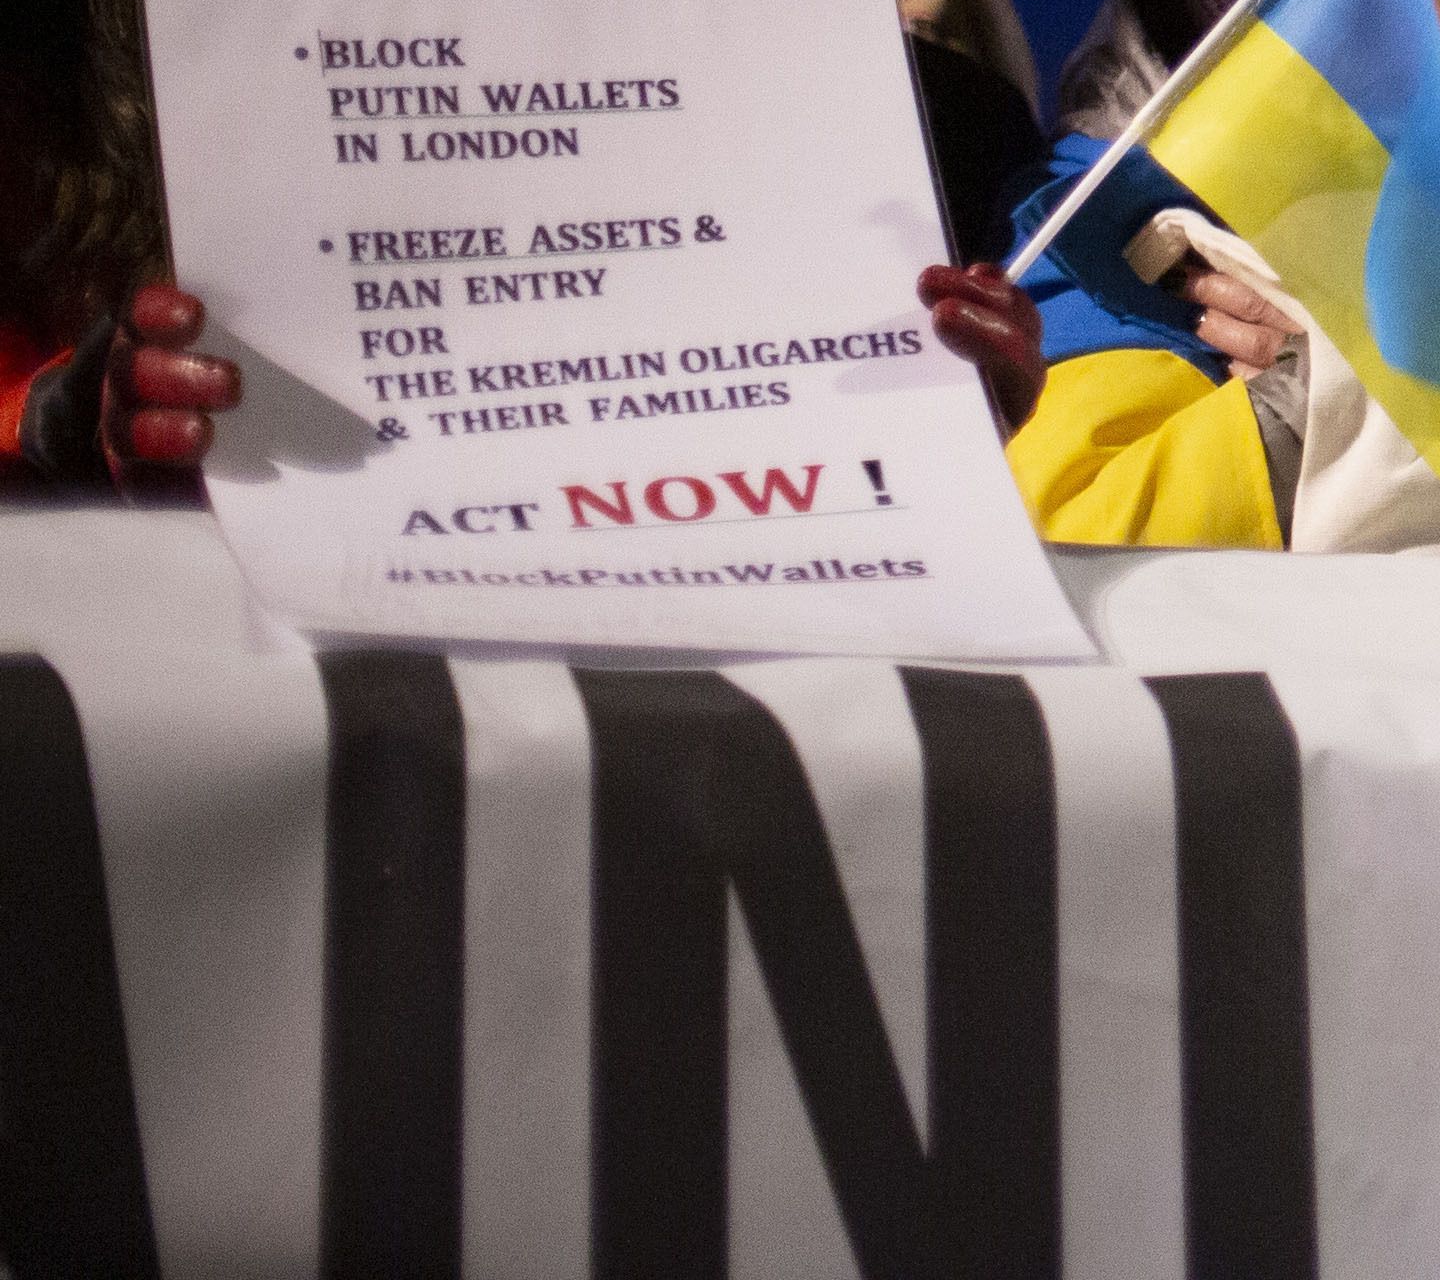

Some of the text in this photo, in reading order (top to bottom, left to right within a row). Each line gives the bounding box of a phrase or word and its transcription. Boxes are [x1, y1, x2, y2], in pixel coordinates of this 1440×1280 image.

[322, 37, 466, 70] BLOCK
[328, 78, 681, 118] PUTIN WALLETS
[334, 126, 581, 163] IN LONDON
[347, 213, 727, 263] FREEZE ASSETS &
[353, 267, 608, 312] BAN ENTRY
[359, 326, 449, 360] FOR
[366, 329, 924, 403] THE KREMLIN OLIGARCHS
[376, 381, 792, 442] & THEIR FAMILIES
[400, 458, 894, 536] ACT NOW !
[386, 558, 929, 589] #BlockPutinWallets
